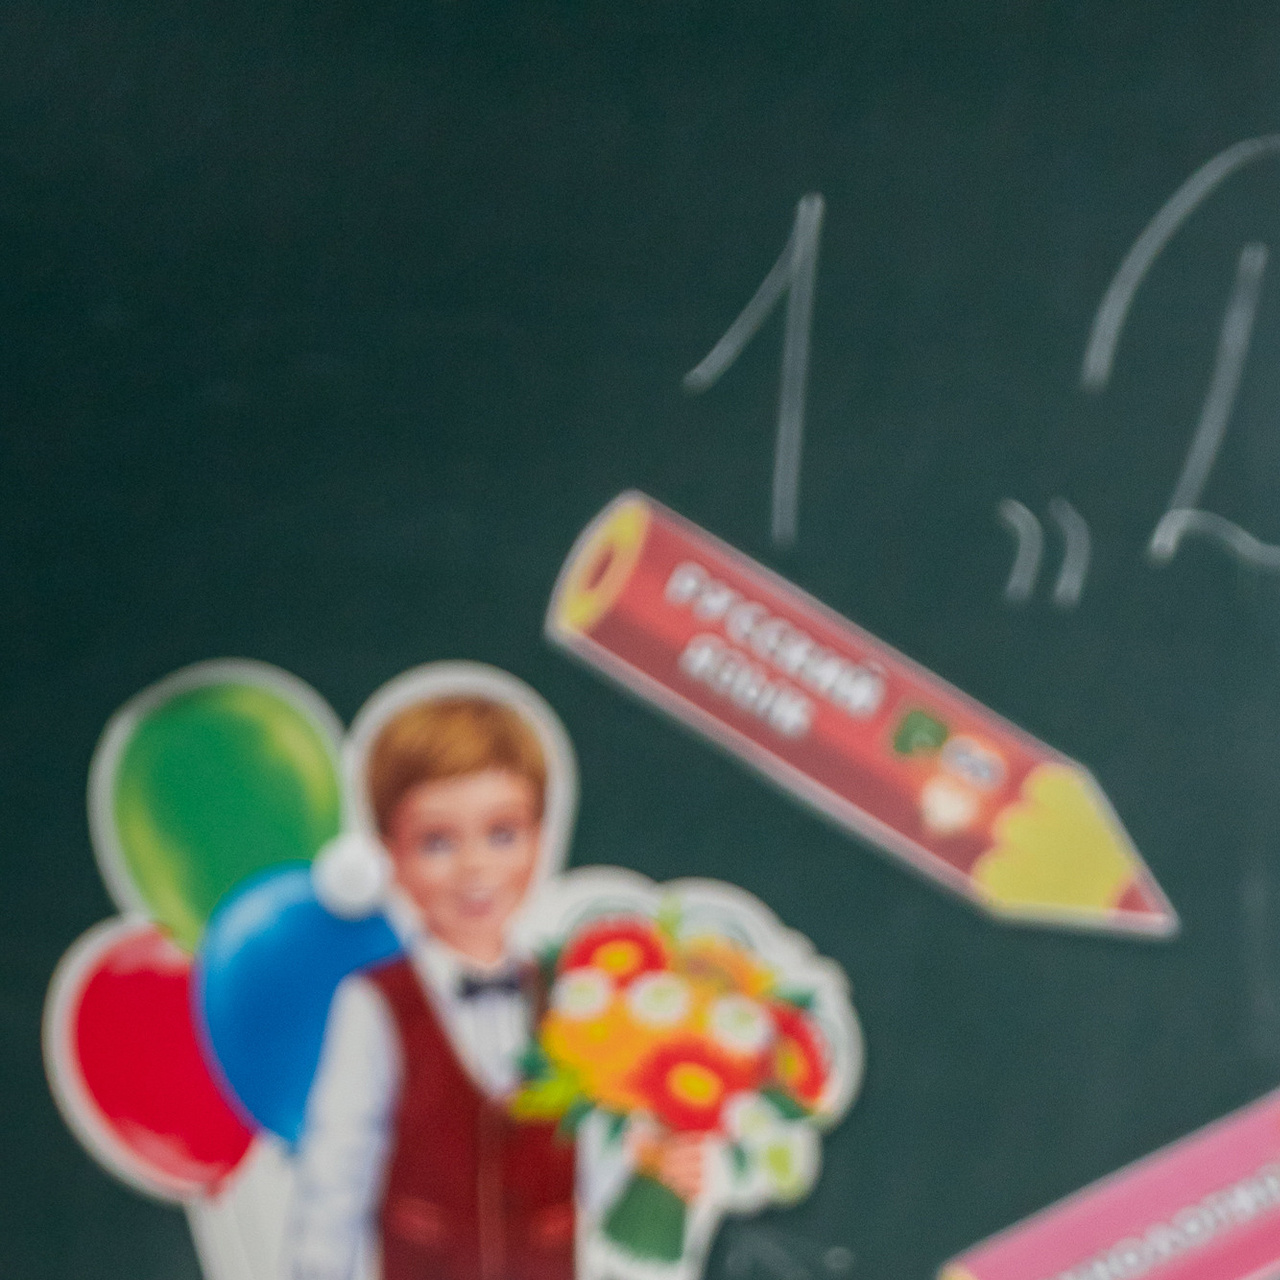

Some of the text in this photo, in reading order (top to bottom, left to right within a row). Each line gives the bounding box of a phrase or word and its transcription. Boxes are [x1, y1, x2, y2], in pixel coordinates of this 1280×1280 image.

[683, 190, 825, 550] 1
[663, 560, 886, 720] РУССКИЙ
[677, 631, 816, 738] ЯЗЫК
